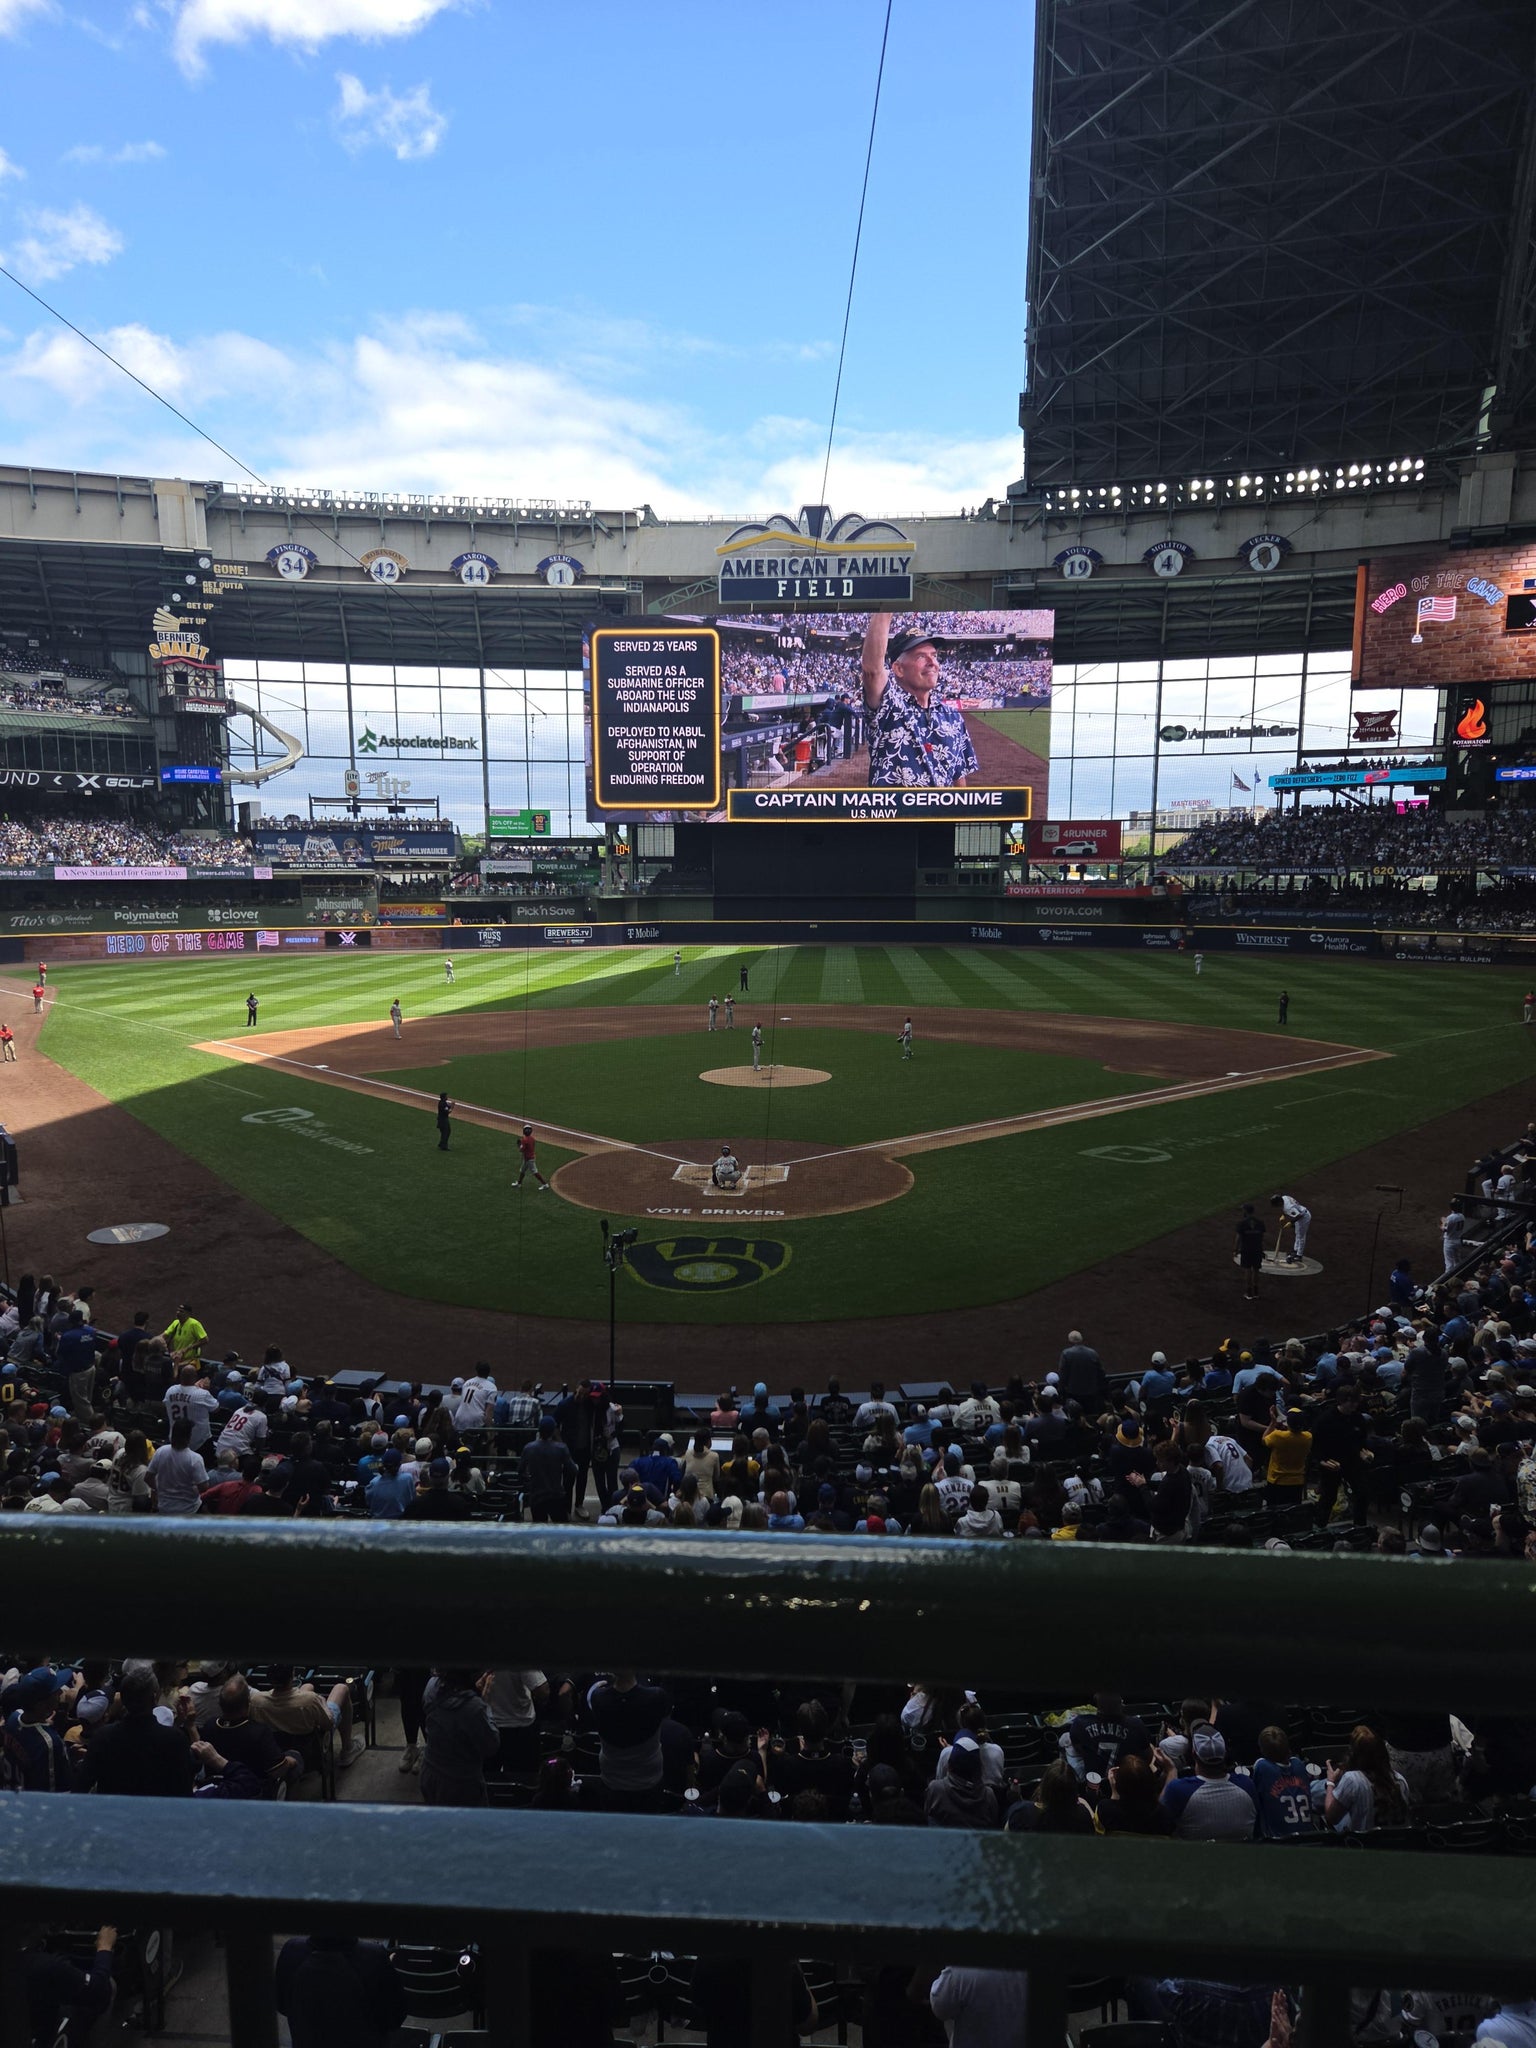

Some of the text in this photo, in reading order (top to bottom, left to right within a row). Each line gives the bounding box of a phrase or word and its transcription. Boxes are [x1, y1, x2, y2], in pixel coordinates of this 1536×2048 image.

[1249, 535, 1281, 545] UECKER
[274, 545, 309, 556] FINGERS
[1065, 548, 1092, 556] YOUNT
[1151, 542, 1187, 553] MOLITOR
[366, 550, 402, 561] ROBINSON
[462, 553, 487, 563] AARON
[548, 555, 571, 563] SELIG
[282, 557, 304, 573] 34
[722, 556, 911, 576] AMERICAN FAMILY
[1067, 560, 1088, 576] 19
[1161, 555, 1173, 571] 4
[213, 564, 248, 575] GONE!
[374, 562, 396, 578] 42
[464, 567, 485, 582] 44
[556, 569, 566, 584] 1
[778, 579, 853, 597] FIELD
[1371, 574, 1505, 614] HERO OF THE GAME
[157, 632, 200, 643] BERNIE'S
[149, 642, 209, 661] CHALET
[613, 641, 697, 652] SERVED 25 YEARS
[625, 666, 686, 676] SERVED AS A
[607, 678, 704, 688] SUBMARINE OFFICER
[616, 690, 696, 701] ABOARD THE USS
[623, 702, 689, 713] INDIANAPOLIS
[608, 727, 706, 738] DEPLOYED TO KABUL,
[616, 739, 697, 750] AFGHANISTAN, IN
[628, 751, 685, 761] SUPPORT OF
[631, 763, 683, 773] OPERATION
[105, 778, 154, 788] GOLF
[610, 775, 704, 785] ENDURING FREEDOM
[376, 778, 411, 798] Lite
[755, 792, 1003, 807] CAPTAIN MARK GERONIME
[1171, 799, 1211, 807] MASTERSON
[851, 809, 897, 819] U.S. NAVY
[1063, 829, 1107, 838] 4RUNNER
[371, 839, 405, 854] Miller
[1373, 866, 1431, 875] 620 WTMJ
[1009, 886, 1087, 895] TOYOTA TERRITORY
[315, 897, 364, 910] Johnsonville
[114, 911, 178, 921] Polymatech
[222, 909, 259, 919] clover
[517, 906, 575, 916] Pick Save
[1036, 906, 1102, 916] TOYOTA.COM
[10, 915, 45, 927] Tito's
[477, 930, 502, 942] TRUSS
[635, 928, 660, 939] Mobile
[978, 927, 1002, 939] Mobile
[106, 931, 245, 954] HERO OF THE GAME
[1236, 933, 1290, 945] WINTRUST
[1325, 935, 1349, 943] Aurora
[1324, 943, 1367, 952] Health Care
[1460, 956, 1492, 964] BULLPEN
[464, 1389, 475, 1404] 11
[171, 1405, 188, 1420] 21
[226, 1414, 248, 1431] 28
[1001, 1496, 1008, 1508] 1
[1085, 1722, 1129, 1740] THAMES
[1097, 1742, 1119, 1766] 7
[1280, 1794, 1312, 1824] 32
